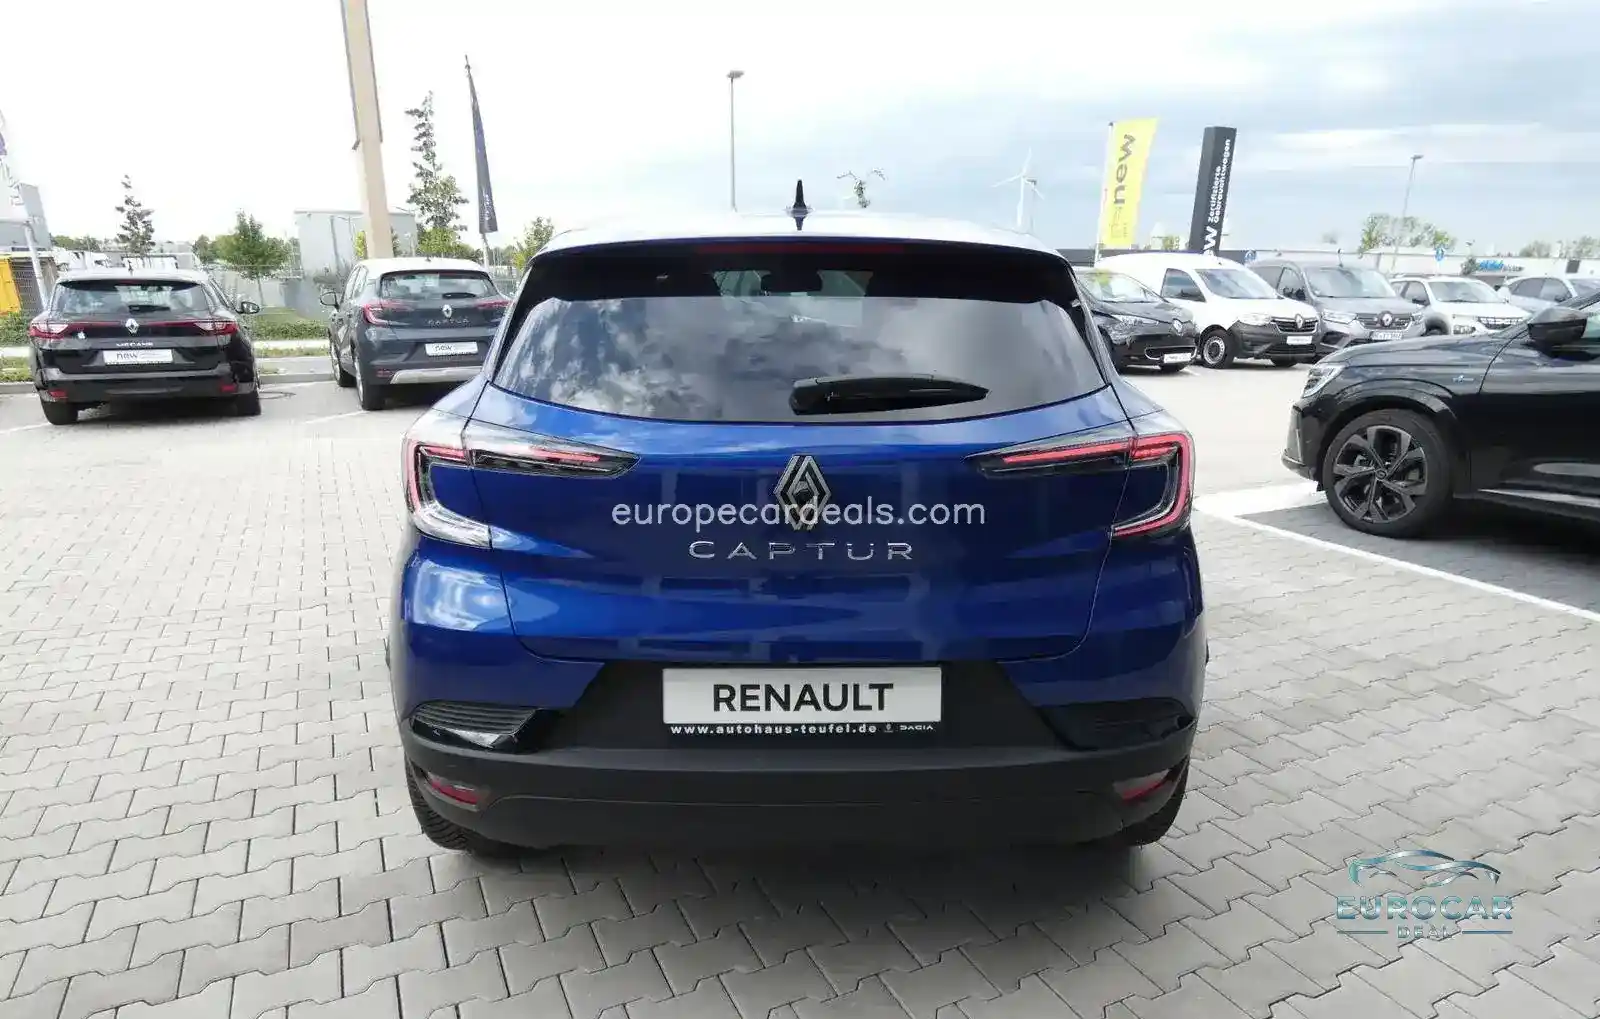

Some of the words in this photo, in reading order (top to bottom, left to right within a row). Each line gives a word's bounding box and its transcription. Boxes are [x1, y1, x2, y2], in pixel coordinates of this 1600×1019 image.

[688, 540, 914, 561] CAPTUR
[713, 684, 895, 713] RENAULT
[670, 723, 877, 735] www.autohaus-teufel.de
